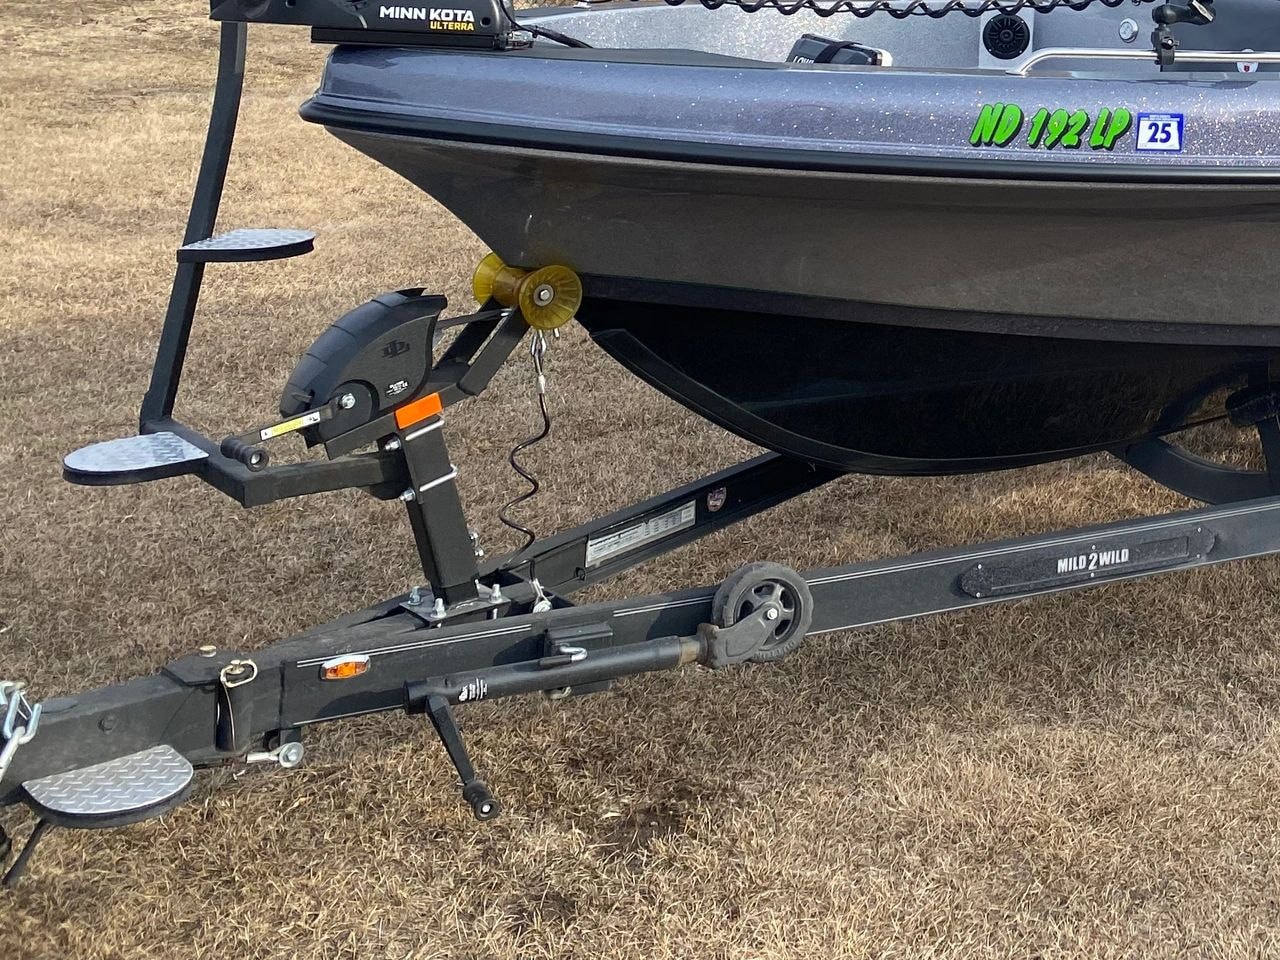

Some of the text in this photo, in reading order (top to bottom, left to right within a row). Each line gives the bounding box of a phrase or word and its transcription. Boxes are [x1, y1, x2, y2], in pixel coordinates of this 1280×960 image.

[379, 5, 475, 22] MINN KOTA
[429, 21, 475, 31] ULTERRA
[968, 102, 1133, 150] ND 192 LP
[1147, 122, 1172, 143] 25
[1057, 555, 1087, 573] MILD
[1099, 548, 1130, 566] WILD
